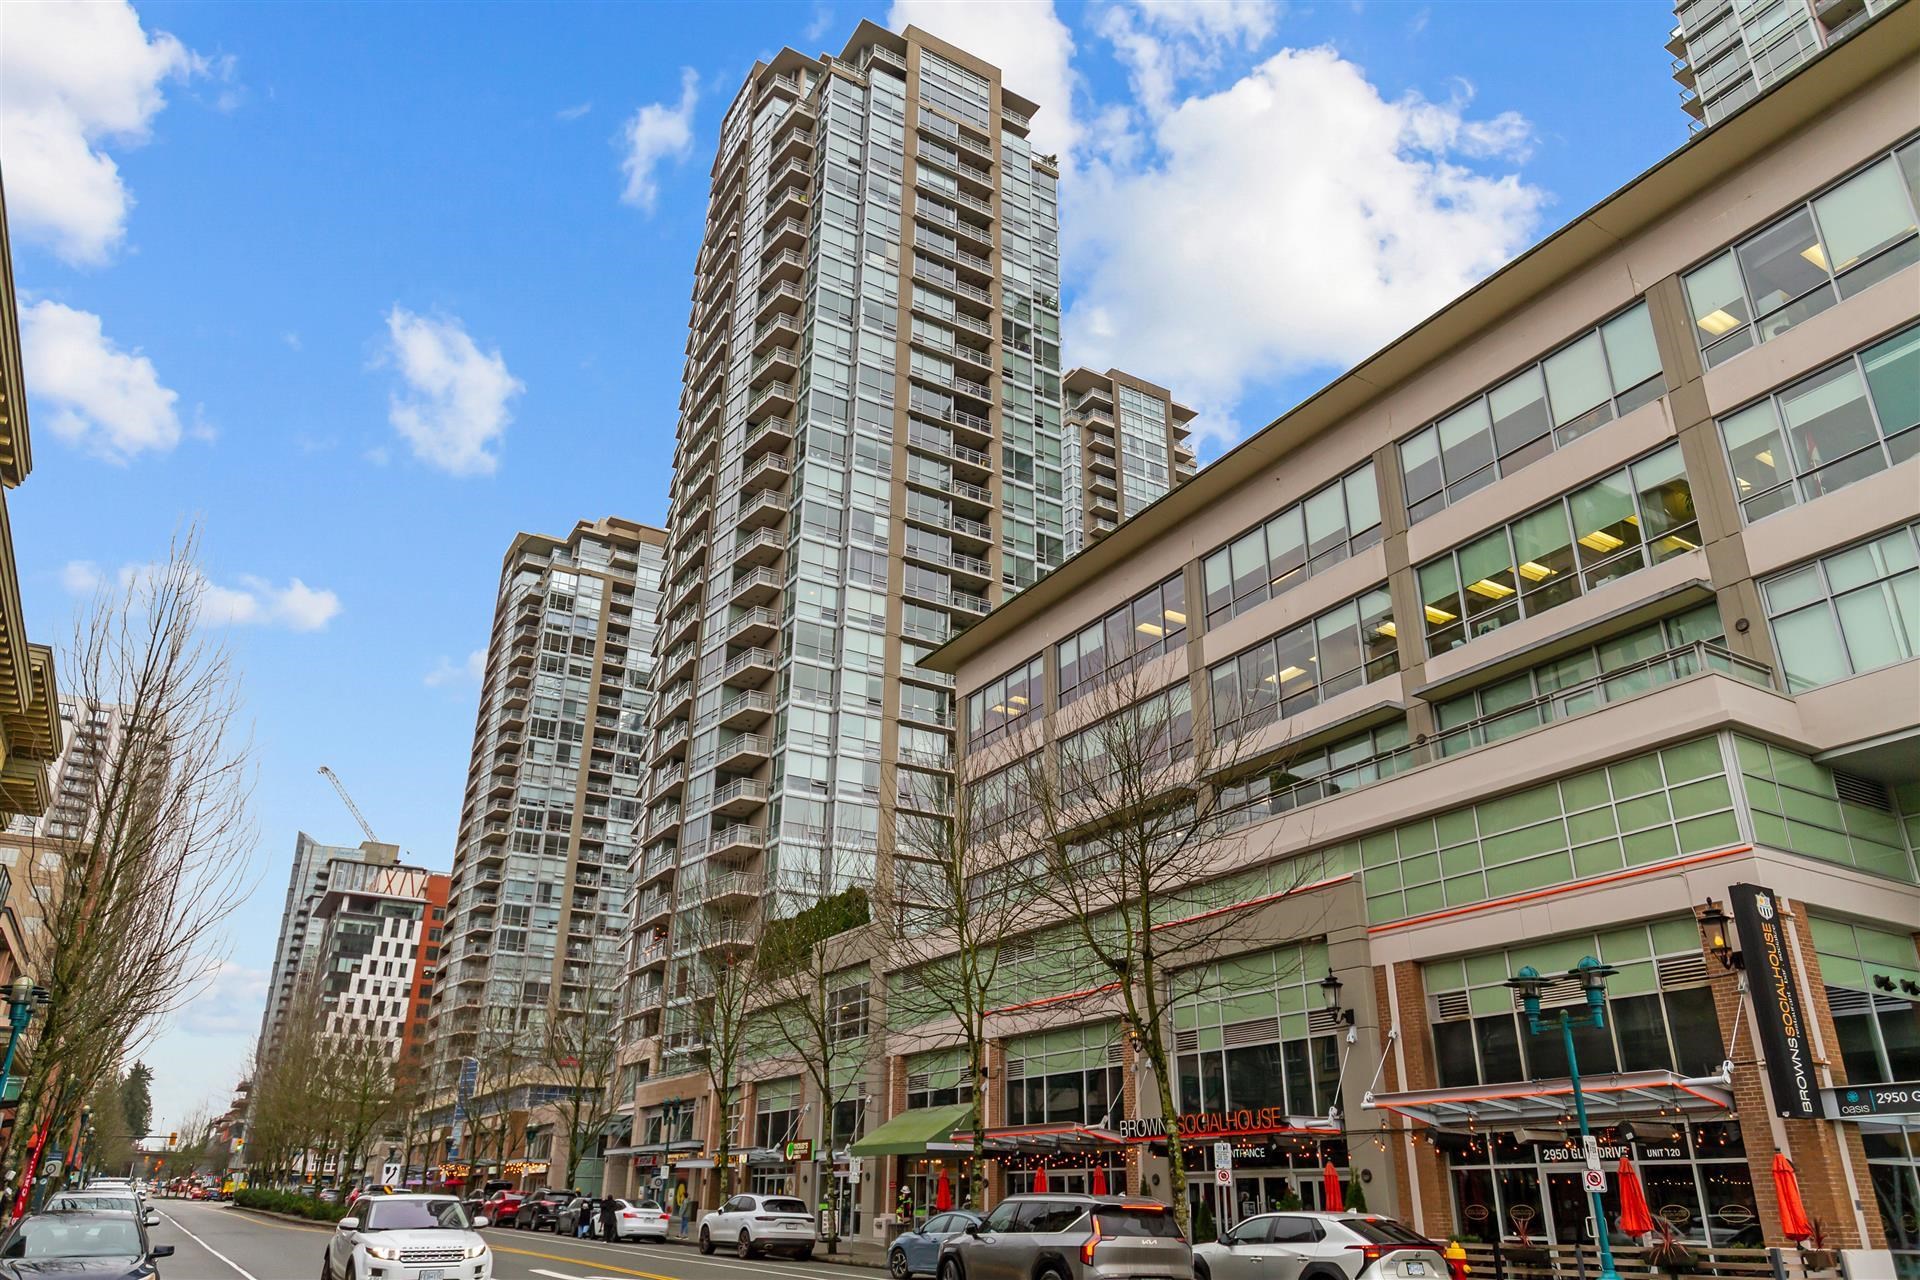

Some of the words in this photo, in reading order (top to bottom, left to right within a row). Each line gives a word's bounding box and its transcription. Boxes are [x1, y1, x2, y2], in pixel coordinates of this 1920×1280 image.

[1876, 1091, 1908, 1104] 2950
[1119, 1117, 1168, 1138] BROWN
[1177, 1107, 1281, 1135] SOCIALHOUSE
[1230, 1147, 1266, 1159] NTRANCE
[1543, 1148, 1569, 1160] 2950
[1646, 1148, 1664, 1158] UNIT
[1665, 1147, 1681, 1157] 120
